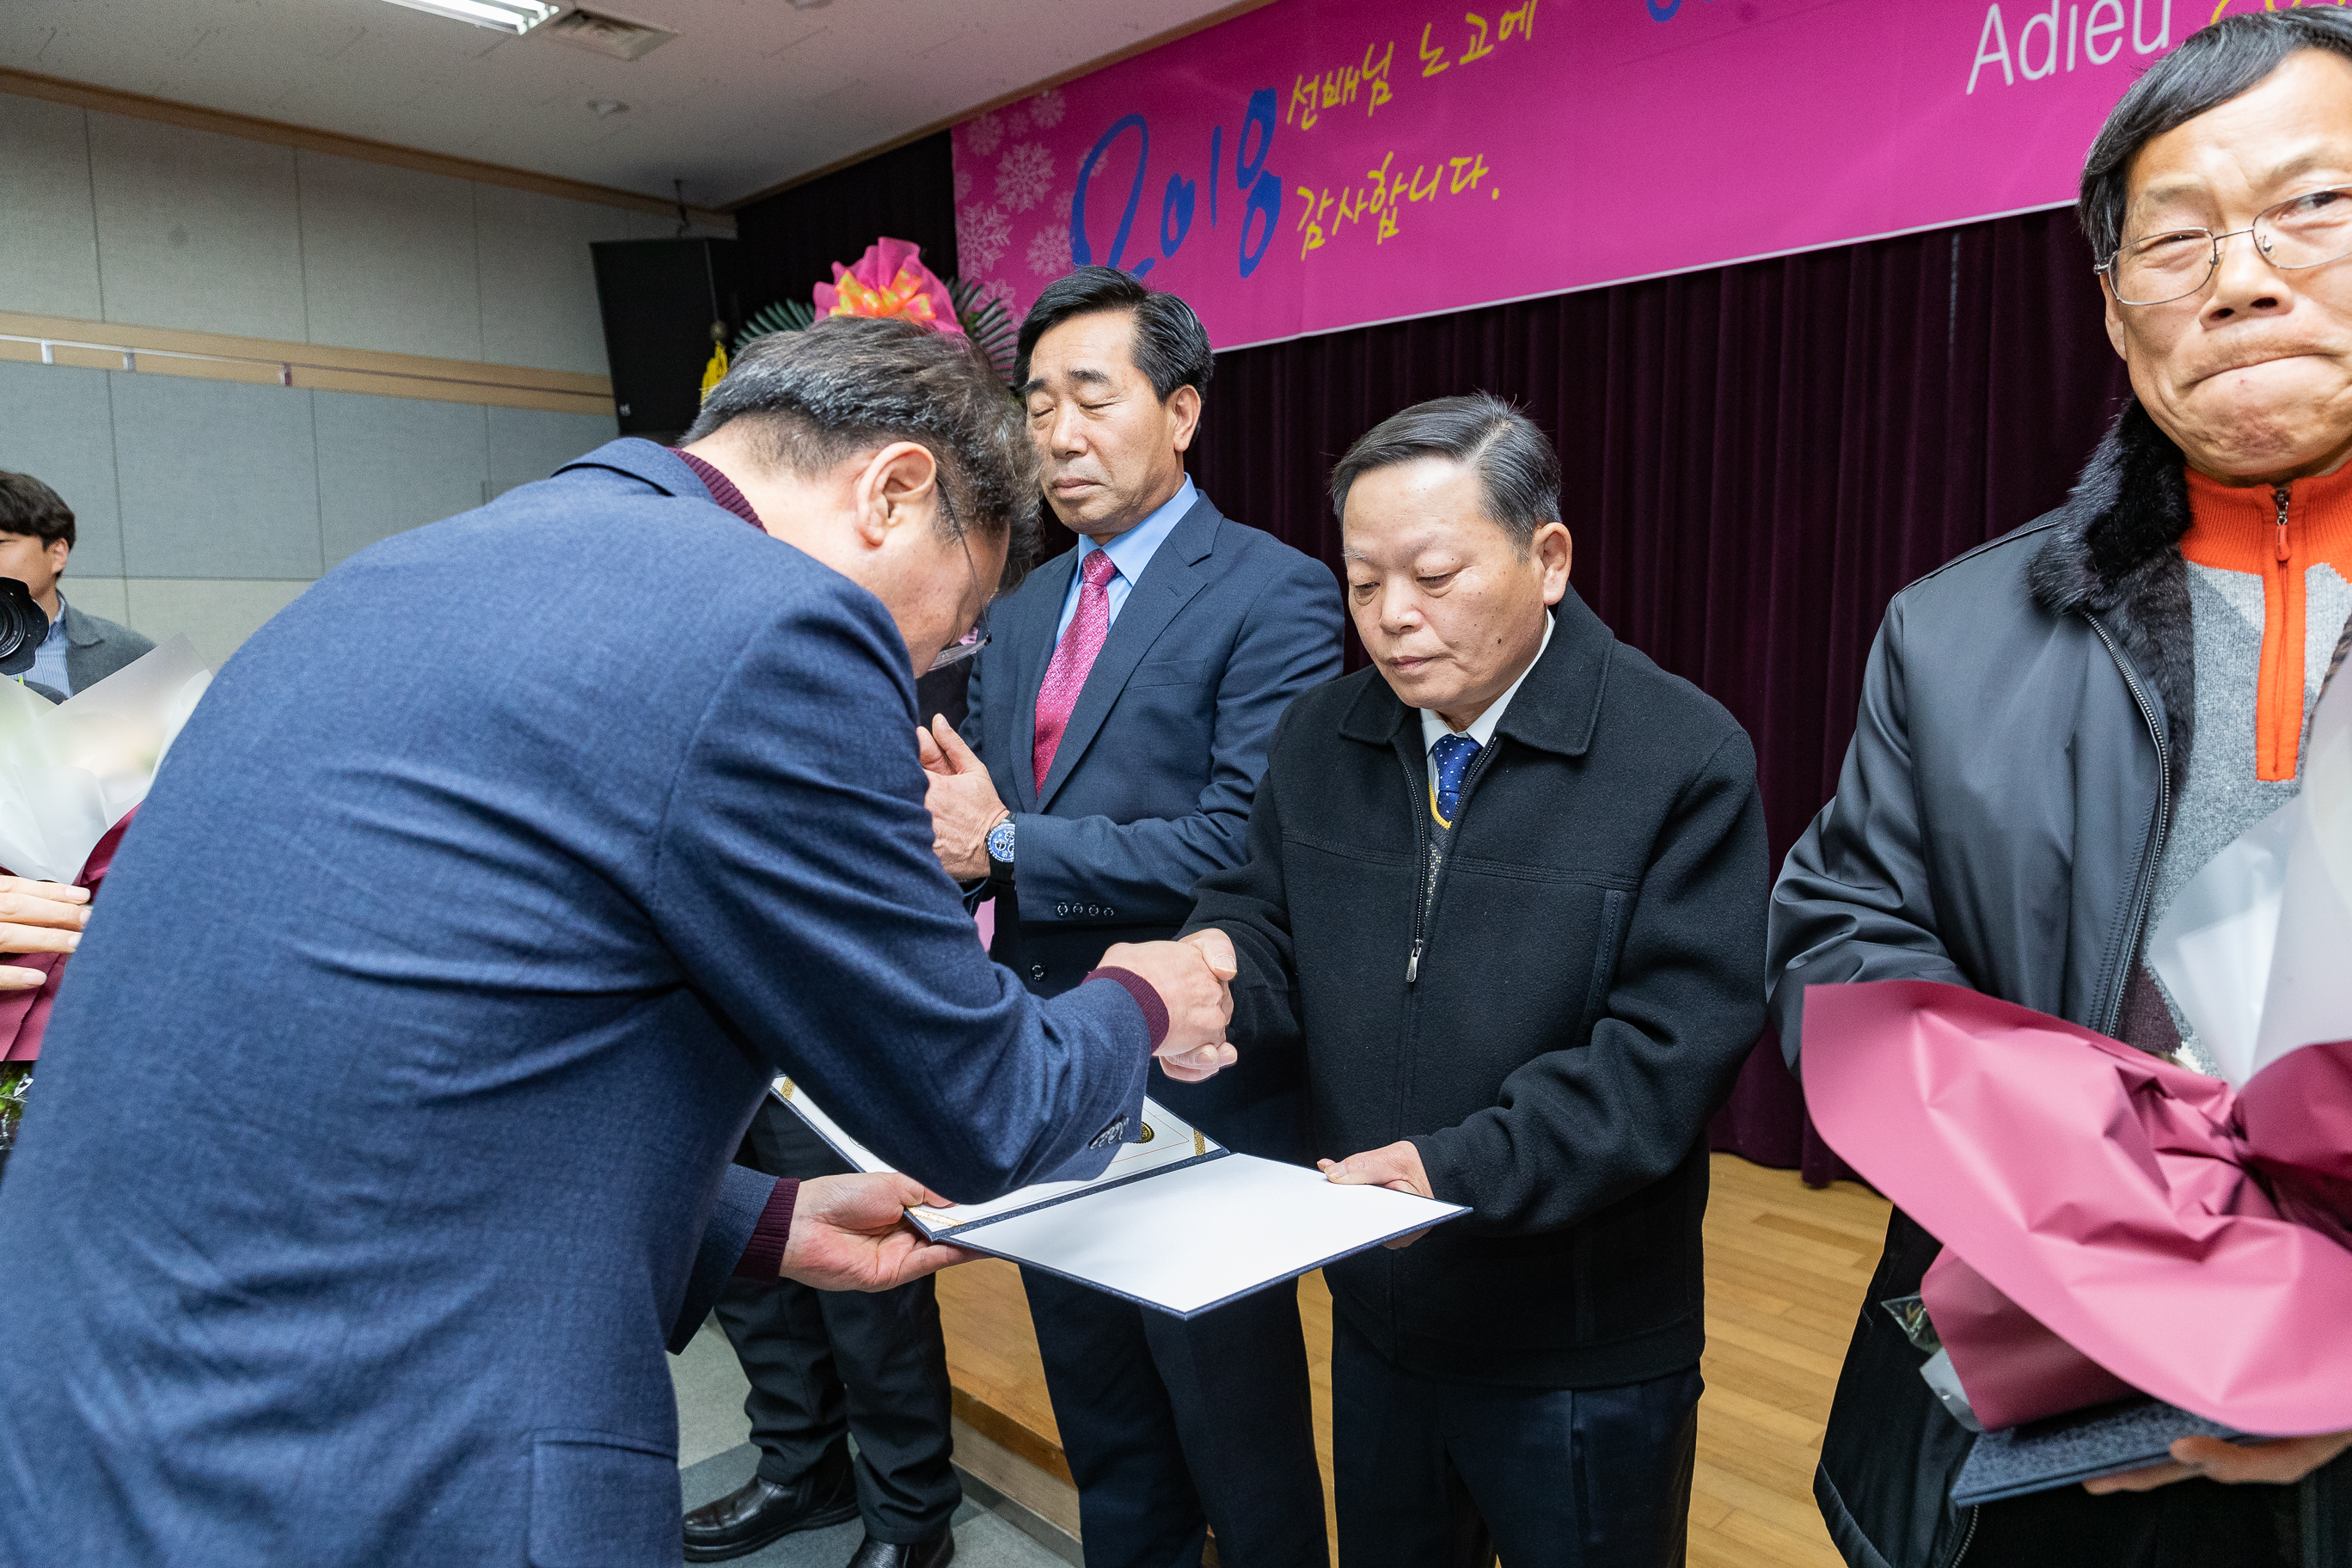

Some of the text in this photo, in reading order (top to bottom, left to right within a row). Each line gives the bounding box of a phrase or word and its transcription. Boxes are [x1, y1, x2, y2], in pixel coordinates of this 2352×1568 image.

[1286, 0, 1538, 131] 선배님 노고에
[1966, 0, 2171, 95] Adieu
[1296, 150, 1499, 261] 감사합니다.
